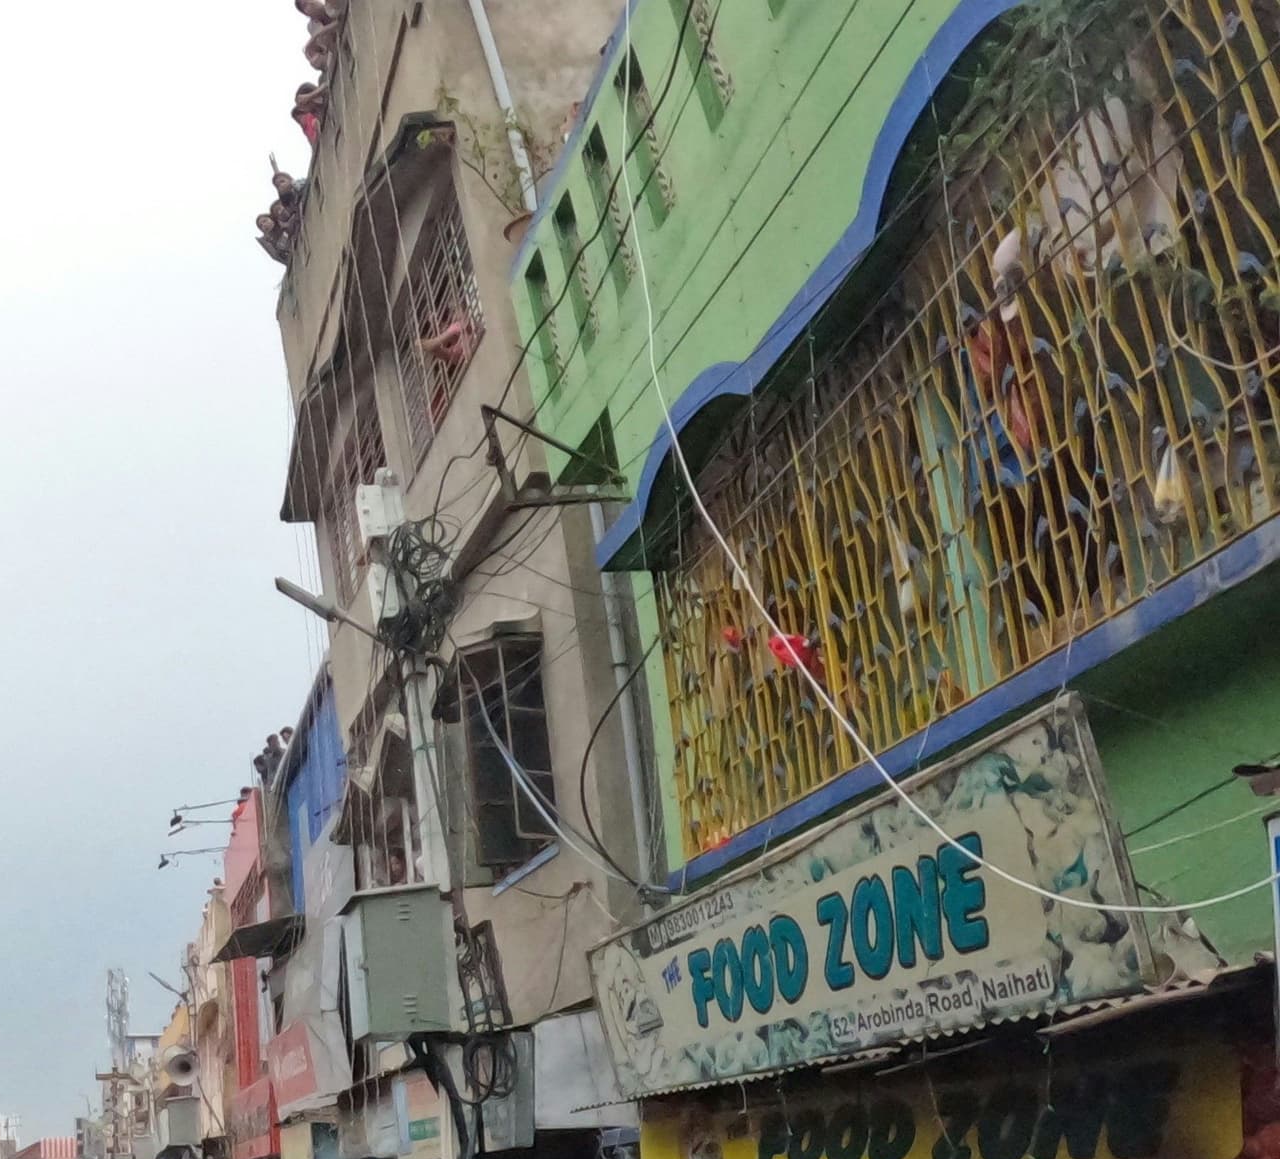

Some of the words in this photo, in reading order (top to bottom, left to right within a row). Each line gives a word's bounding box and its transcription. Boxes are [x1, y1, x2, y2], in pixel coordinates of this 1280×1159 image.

[661, 955, 682, 994] THE
[688, 914, 808, 1028] FOOD
[817, 832, 989, 991] ZONE
[856, 999, 925, 1034] Arobinda
[981, 963, 1052, 1003] Naihati
